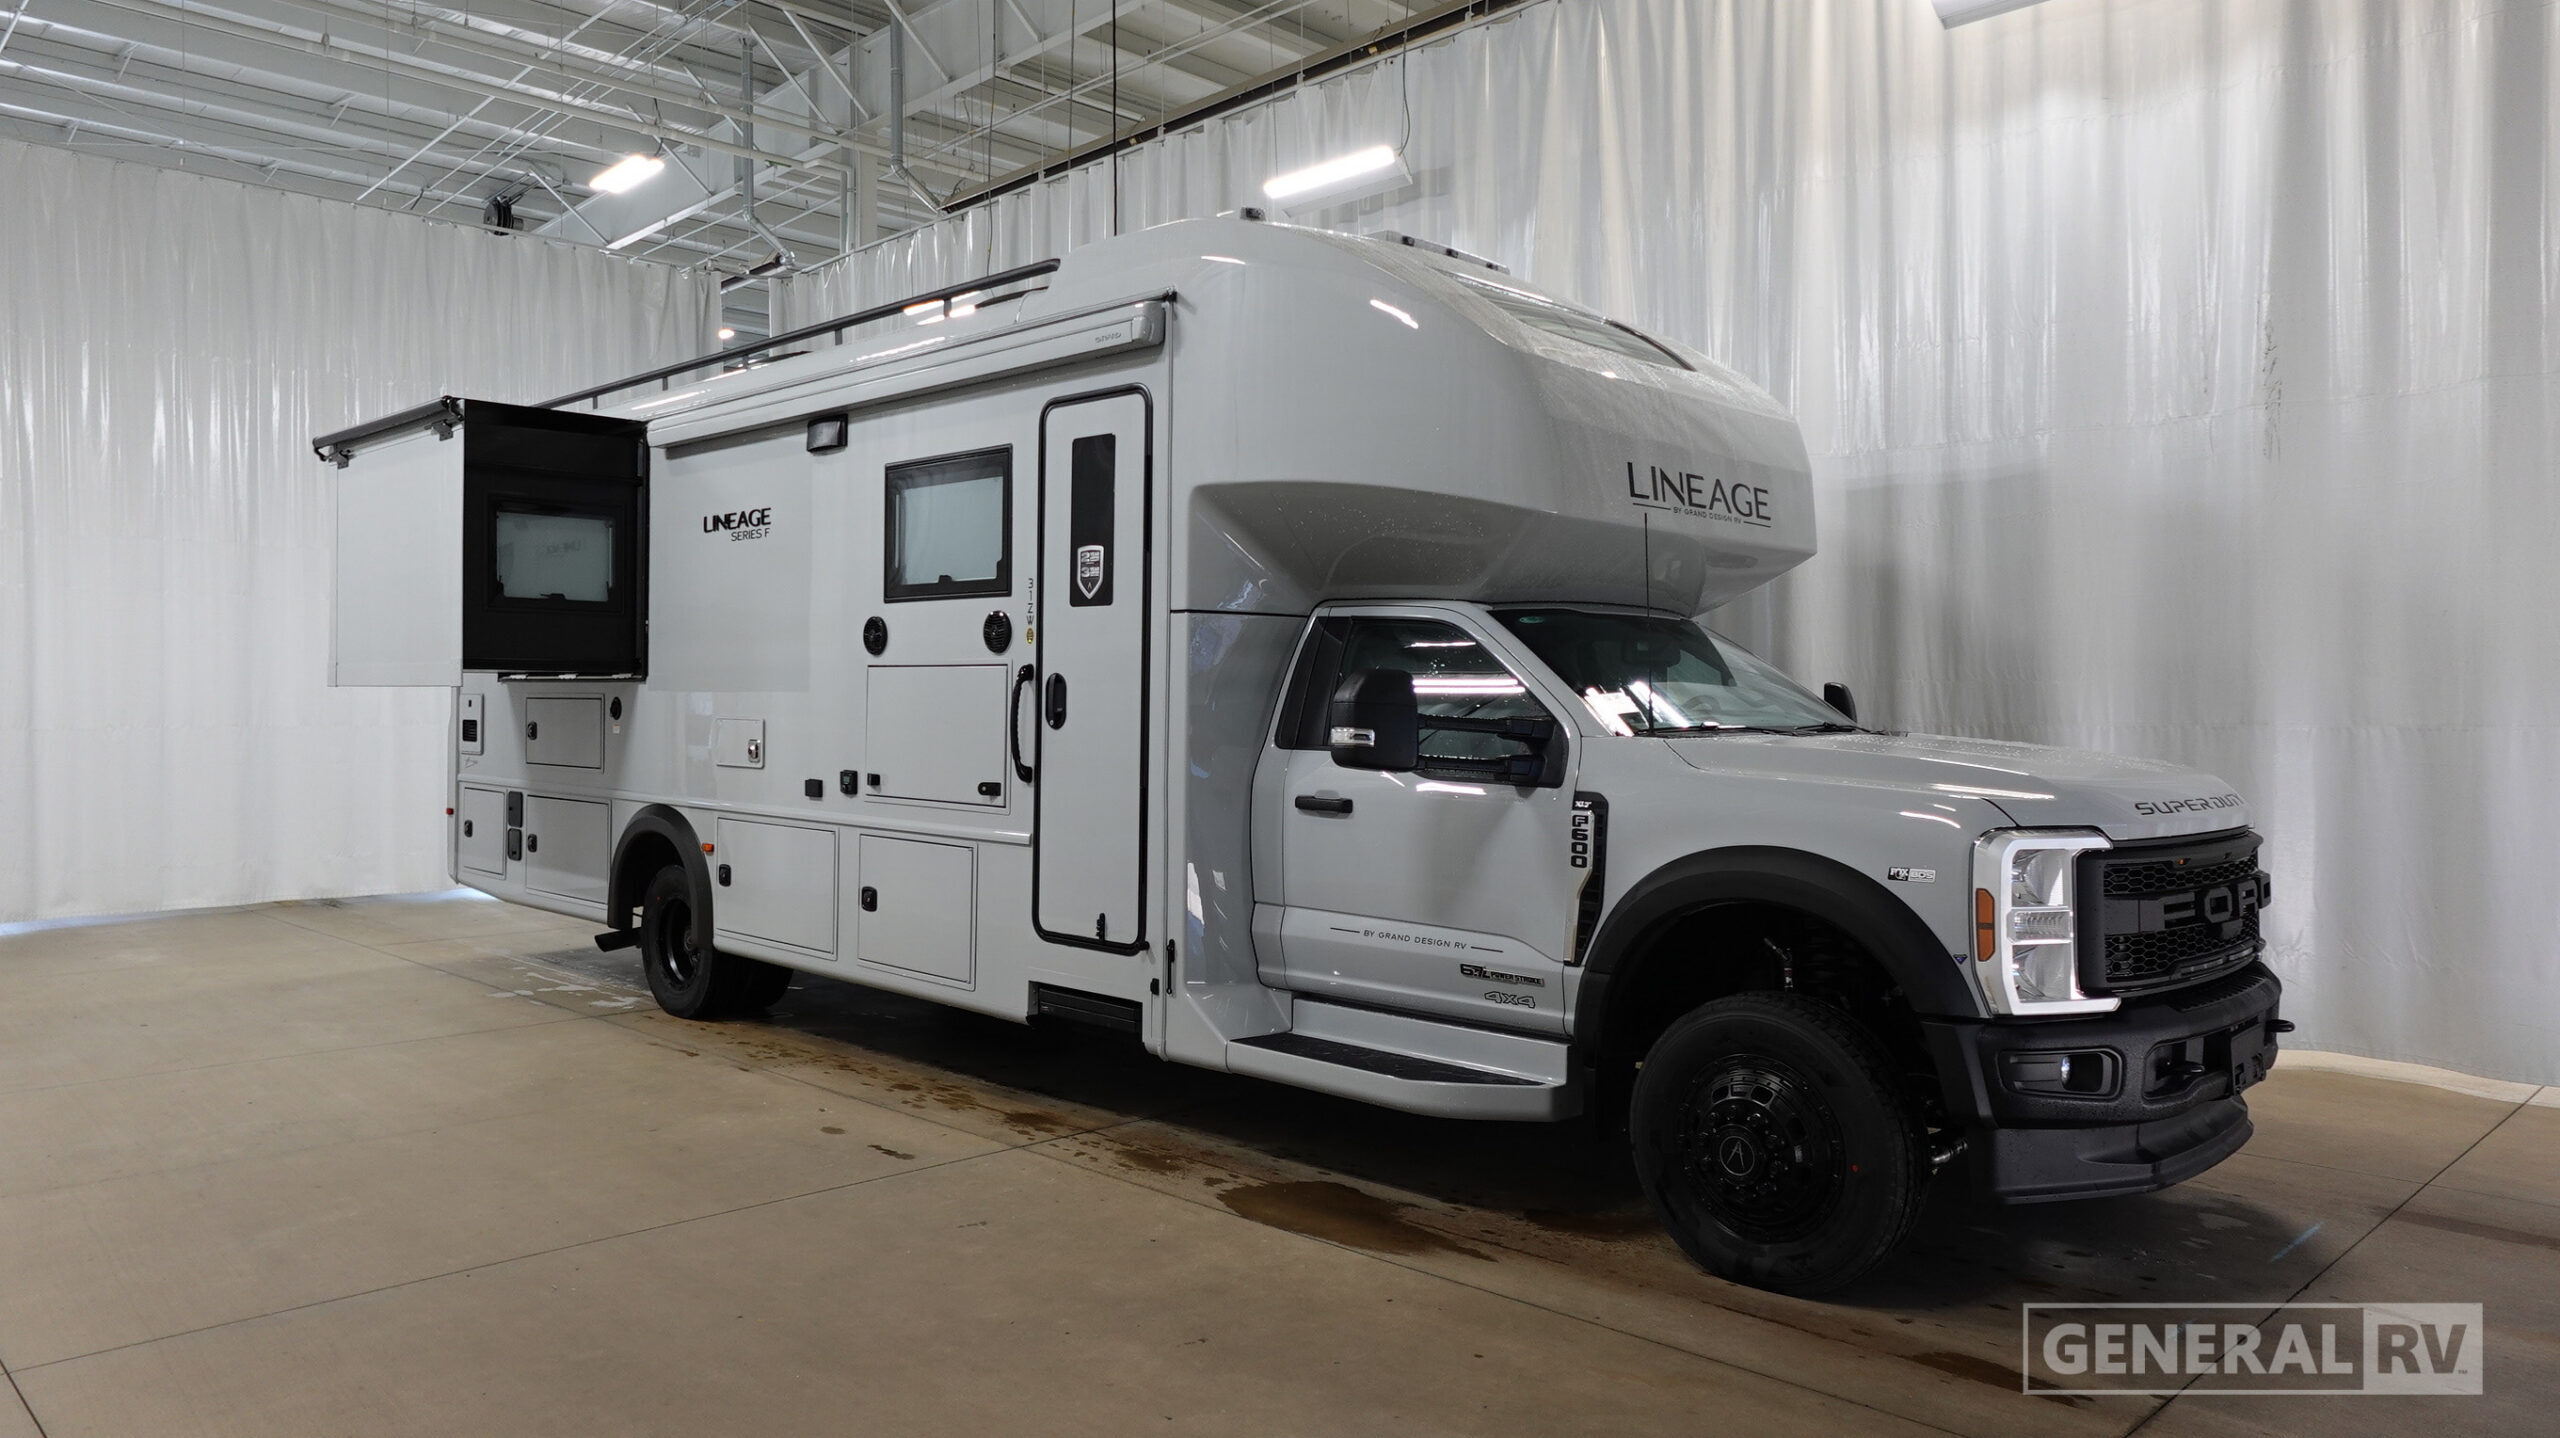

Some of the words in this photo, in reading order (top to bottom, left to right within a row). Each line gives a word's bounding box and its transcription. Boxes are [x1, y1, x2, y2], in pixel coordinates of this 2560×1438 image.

[1627, 462, 1771, 520] LINEAGE
[704, 507, 771, 533] LINEAGE
[731, 528, 762, 541] SERIES
[764, 527, 771, 538] F
[1081, 551, 1090, 562] 2
[1081, 566, 1090, 577] 3
[2134, 798, 2214, 815] SUPER
[1571, 814, 1589, 868] F600
[1363, 929, 1376, 937] BY
[1378, 932, 1411, 942] GRAND
[1414, 936, 1450, 948] DESIGN
[1454, 941, 1467, 950] RV
